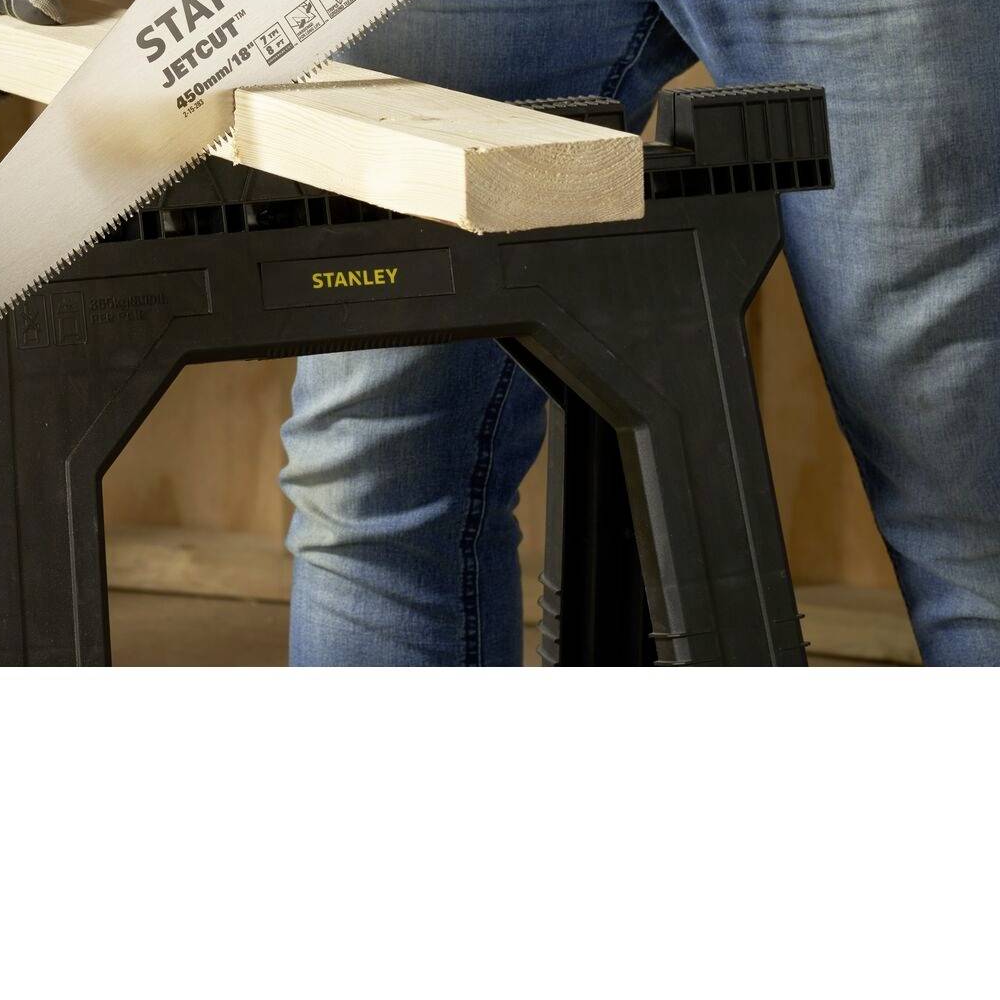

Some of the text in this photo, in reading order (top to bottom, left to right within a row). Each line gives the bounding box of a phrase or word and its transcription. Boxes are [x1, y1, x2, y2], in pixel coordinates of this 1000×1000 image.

[260, 29, 279, 45] 7 TPI
[265, 45, 274, 56] 8
[276, 38, 285, 47] PT
[176, 41, 254, 109] 450mm/18"
[312, 268, 398, 289] STANLEY
